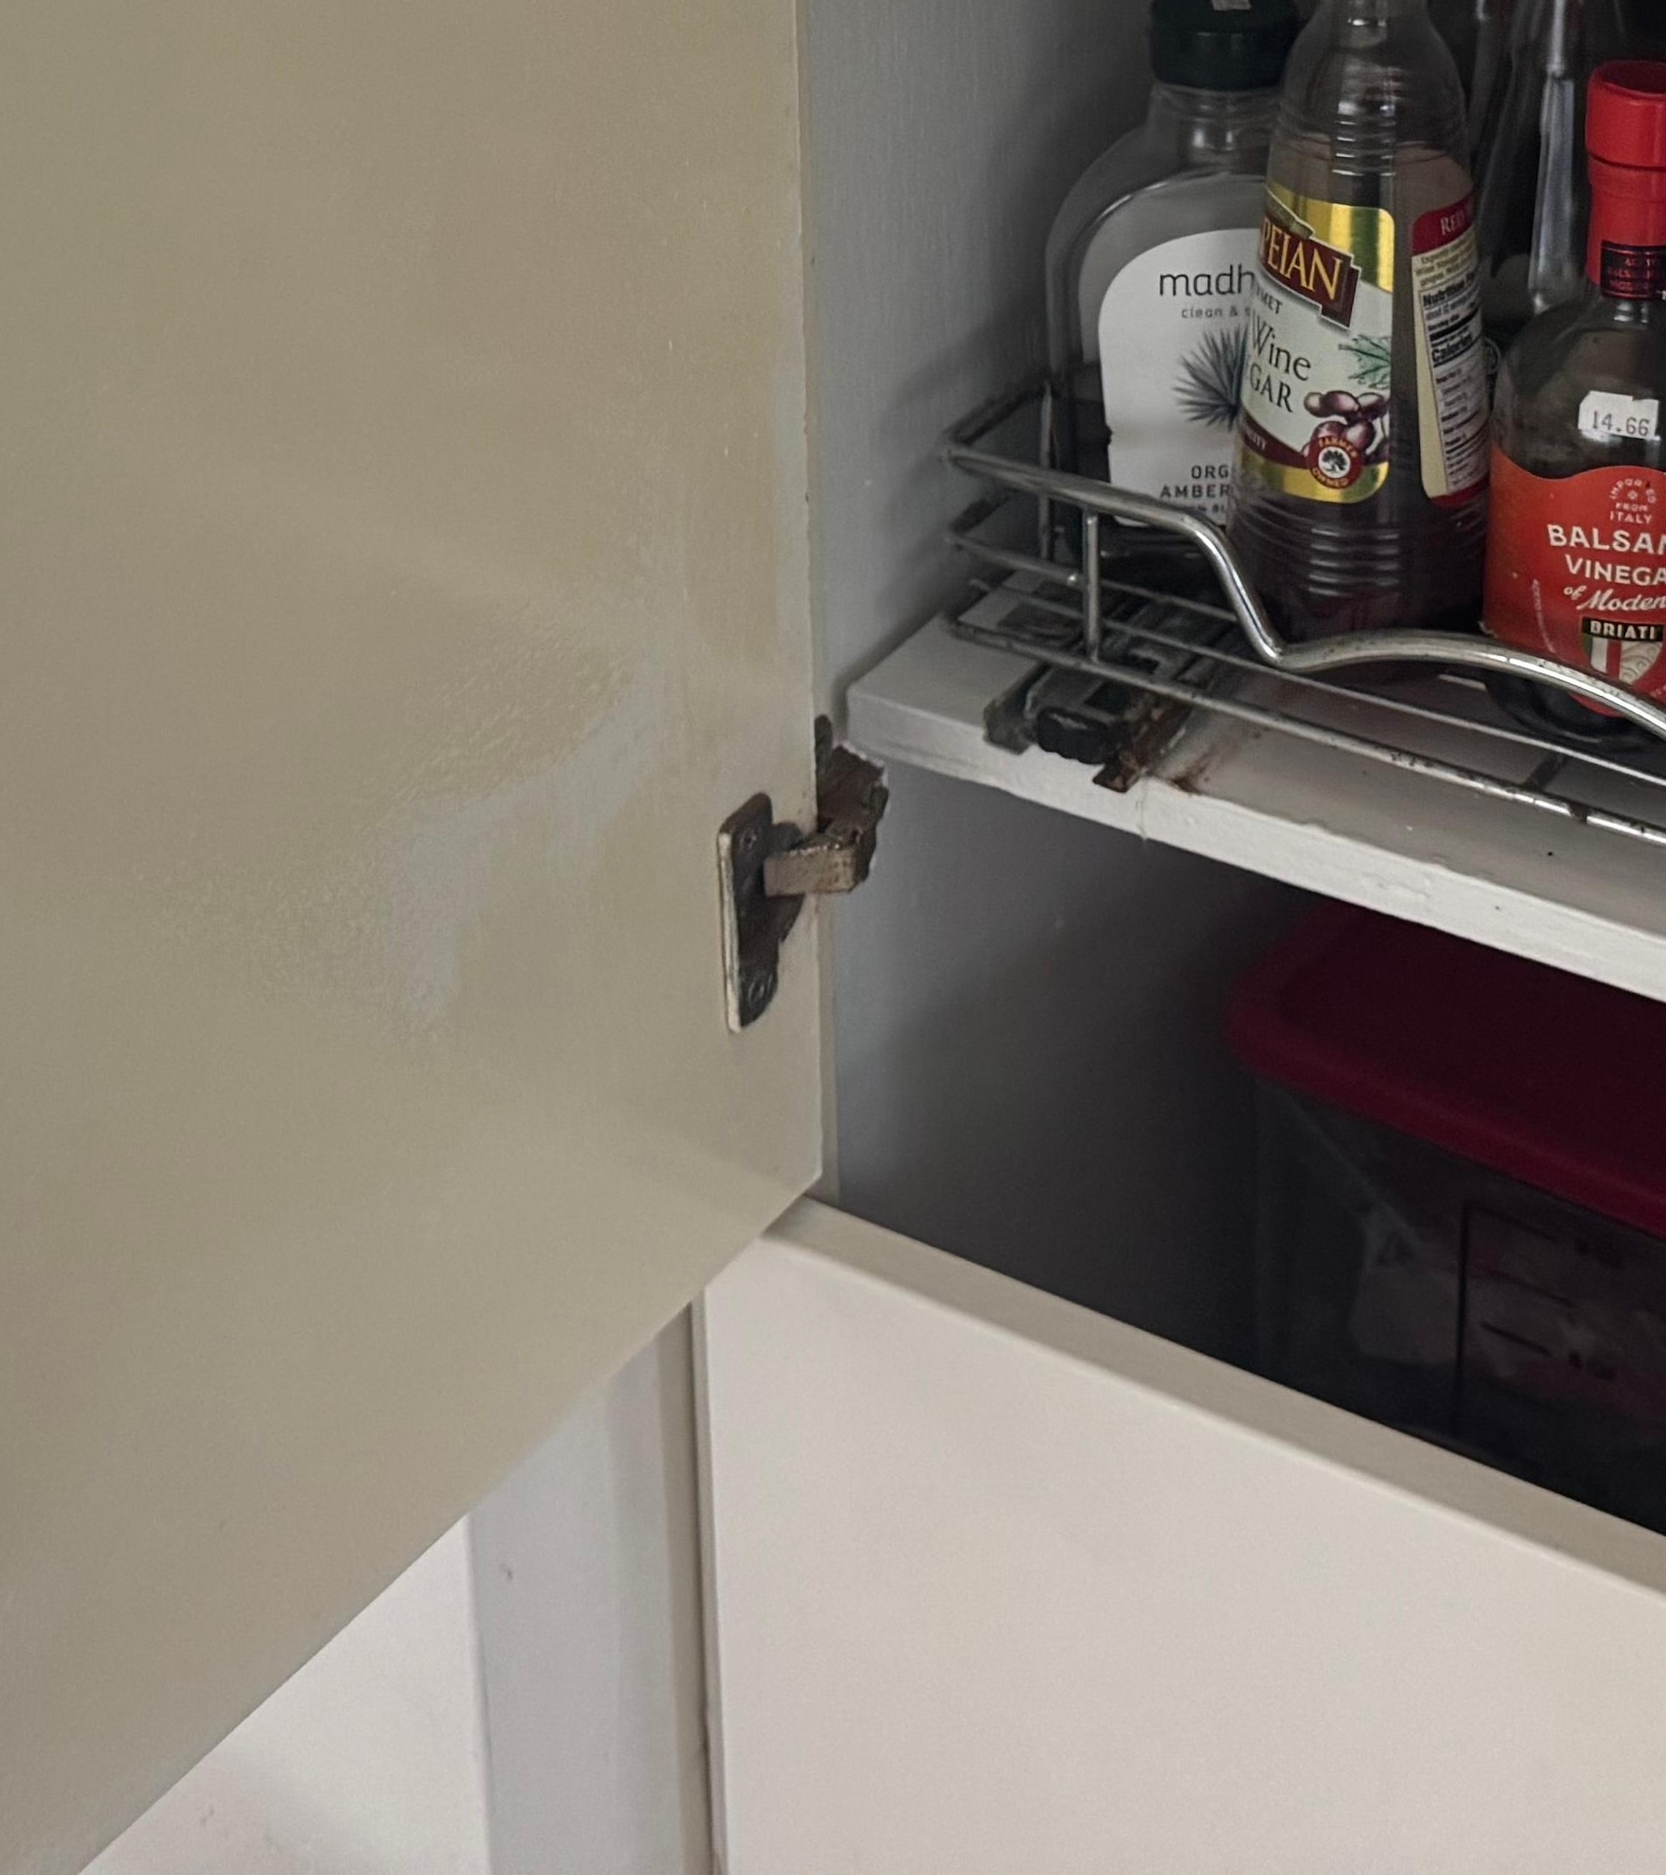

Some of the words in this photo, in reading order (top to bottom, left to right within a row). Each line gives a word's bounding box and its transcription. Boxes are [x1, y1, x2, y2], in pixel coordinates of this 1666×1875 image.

[1260, 216, 1343, 301] PEIAN
[1159, 263, 1256, 296] madh
[1181, 305, 1223, 318] clean
[1249, 362, 1294, 413] GAR
[1592, 410, 1650, 437] 14.66
[1191, 465, 1229, 480] ORG
[1608, 478, 1657, 504] IMPORED
[1609, 511, 1653, 524] ITALY
[1563, 585, 1587, 600] of
[1589, 619, 1656, 640] BRIATI
